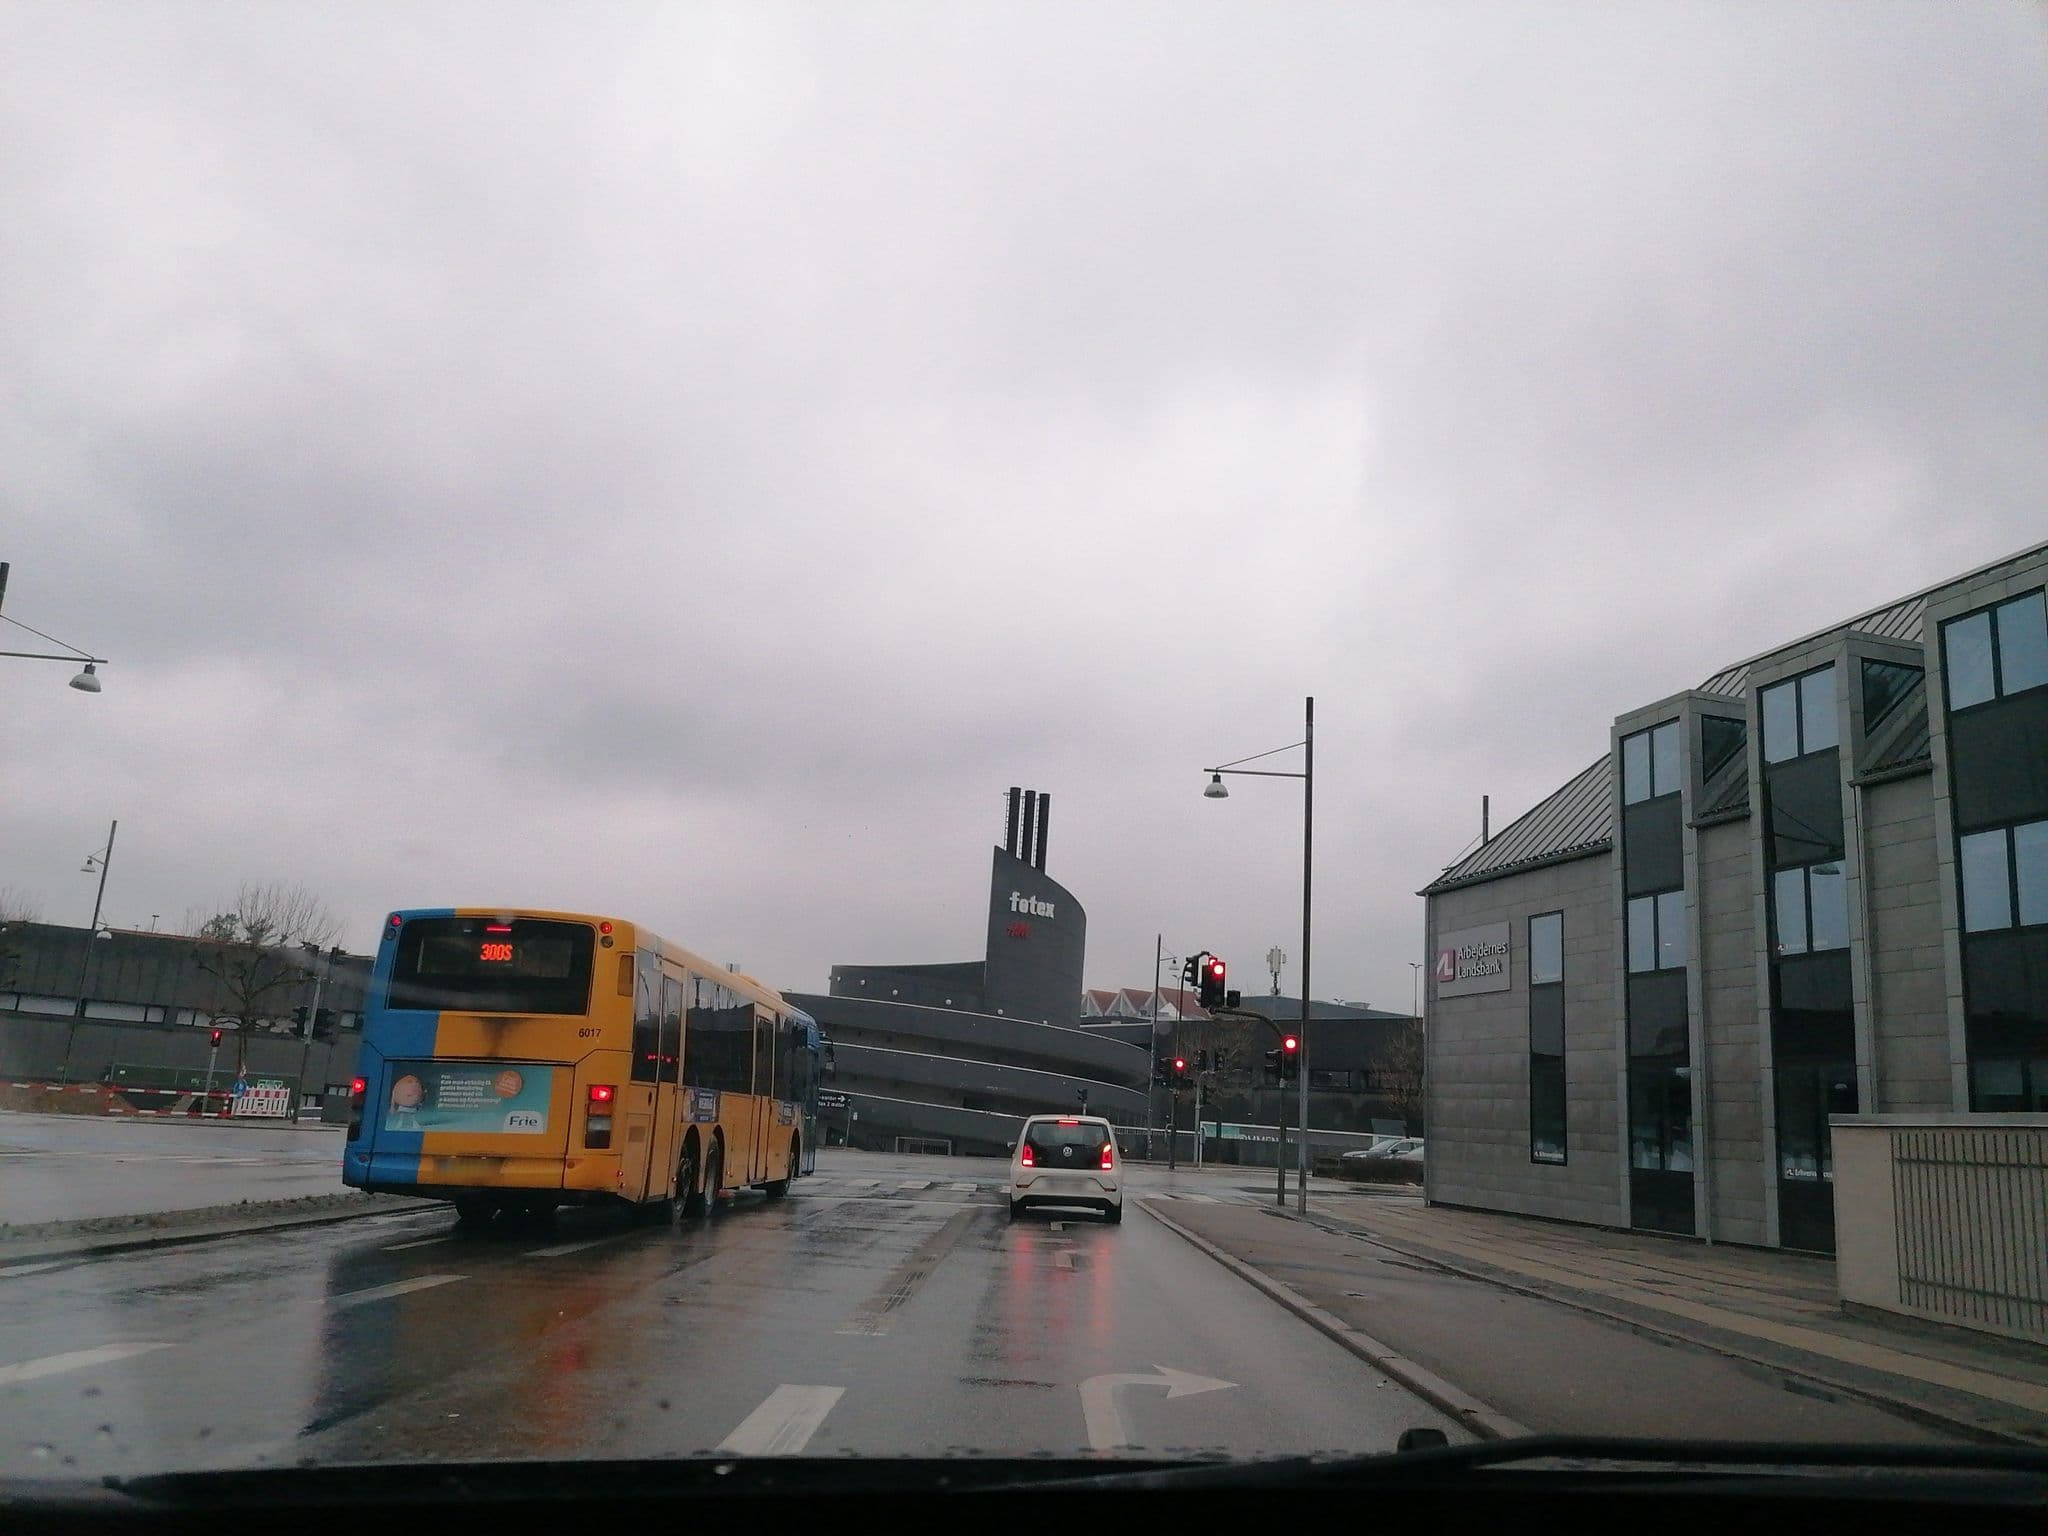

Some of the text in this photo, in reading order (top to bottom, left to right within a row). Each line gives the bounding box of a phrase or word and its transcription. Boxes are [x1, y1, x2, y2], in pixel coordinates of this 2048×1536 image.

[1458, 941, 1507, 960] Arbejdernes
[1457, 959, 1501, 978] Landsbank
[578, 1028, 602, 1038] 6017
[509, 1115, 538, 1127] Frie
